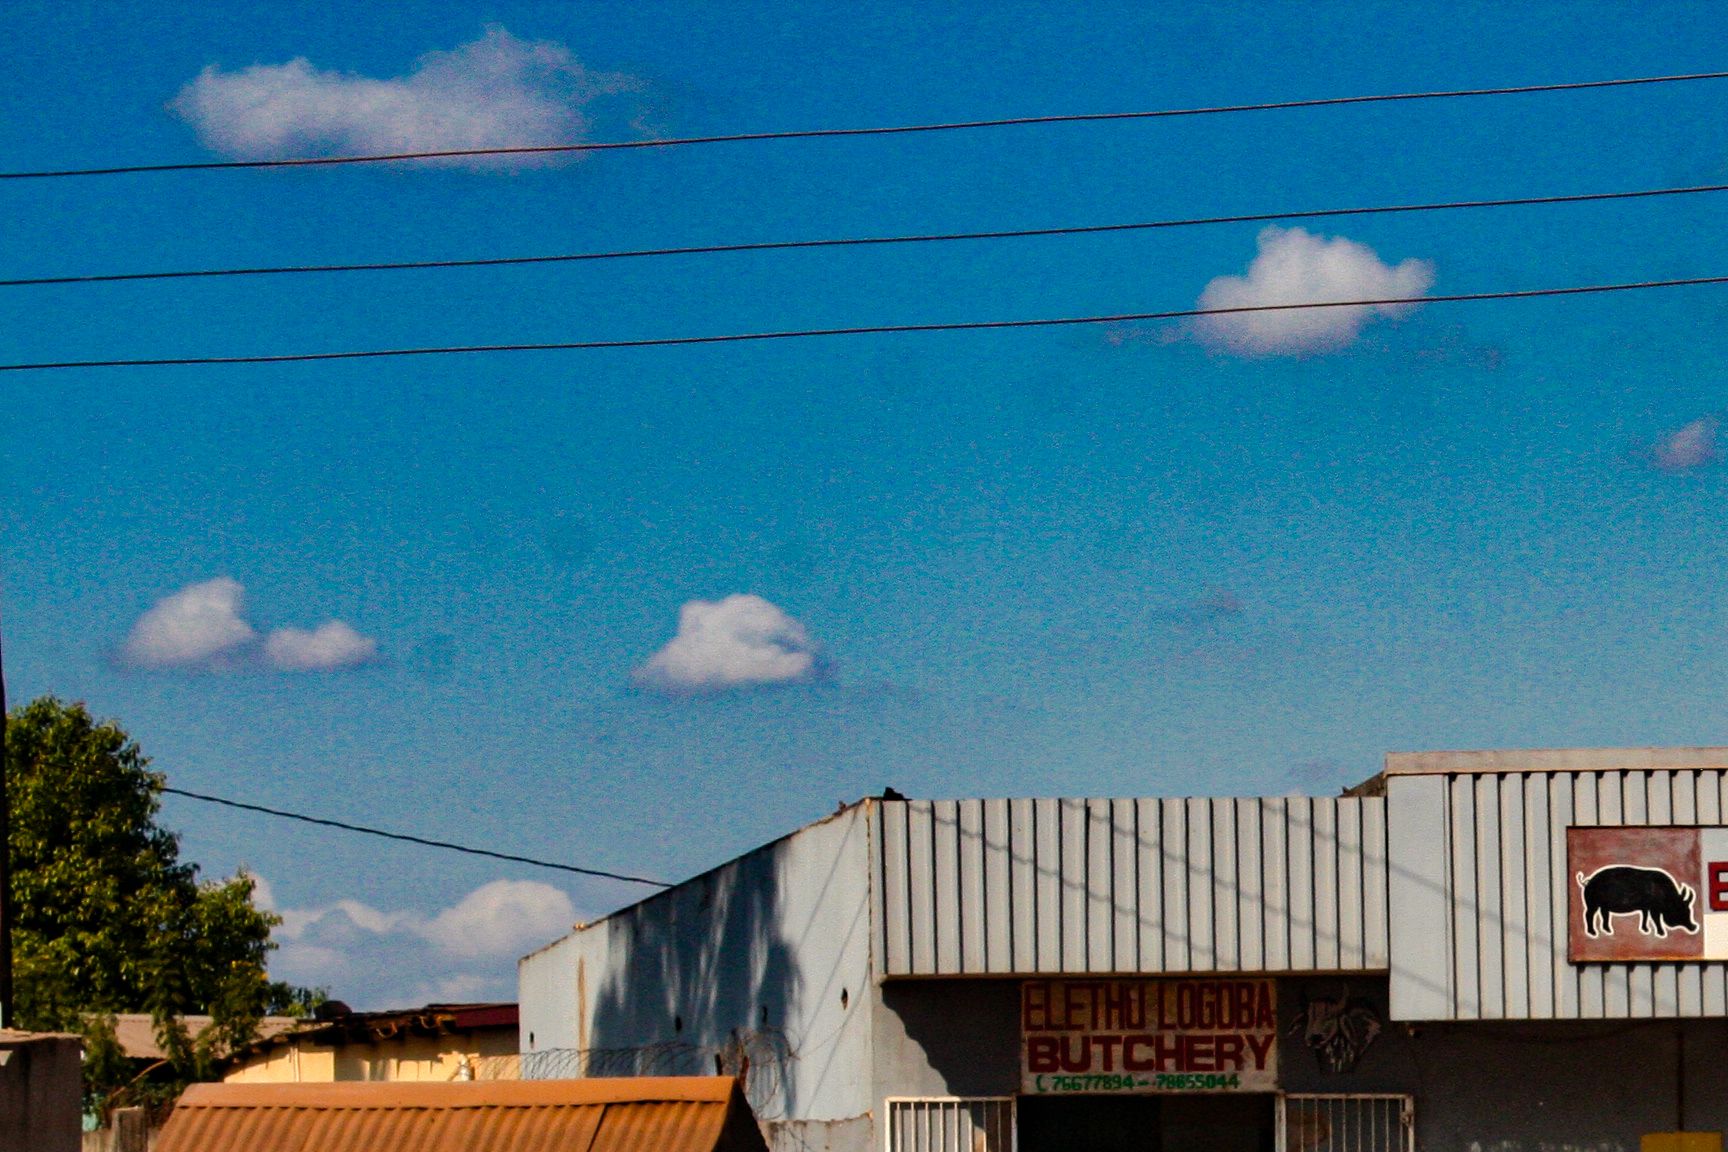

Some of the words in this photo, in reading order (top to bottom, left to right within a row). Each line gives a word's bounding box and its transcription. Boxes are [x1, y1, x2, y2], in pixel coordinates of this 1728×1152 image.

[1024, 981, 1146, 1032] ELETHU
[1157, 980, 1275, 1031] LOGOBA
[1027, 1034, 1276, 1073] BUTCHERY
